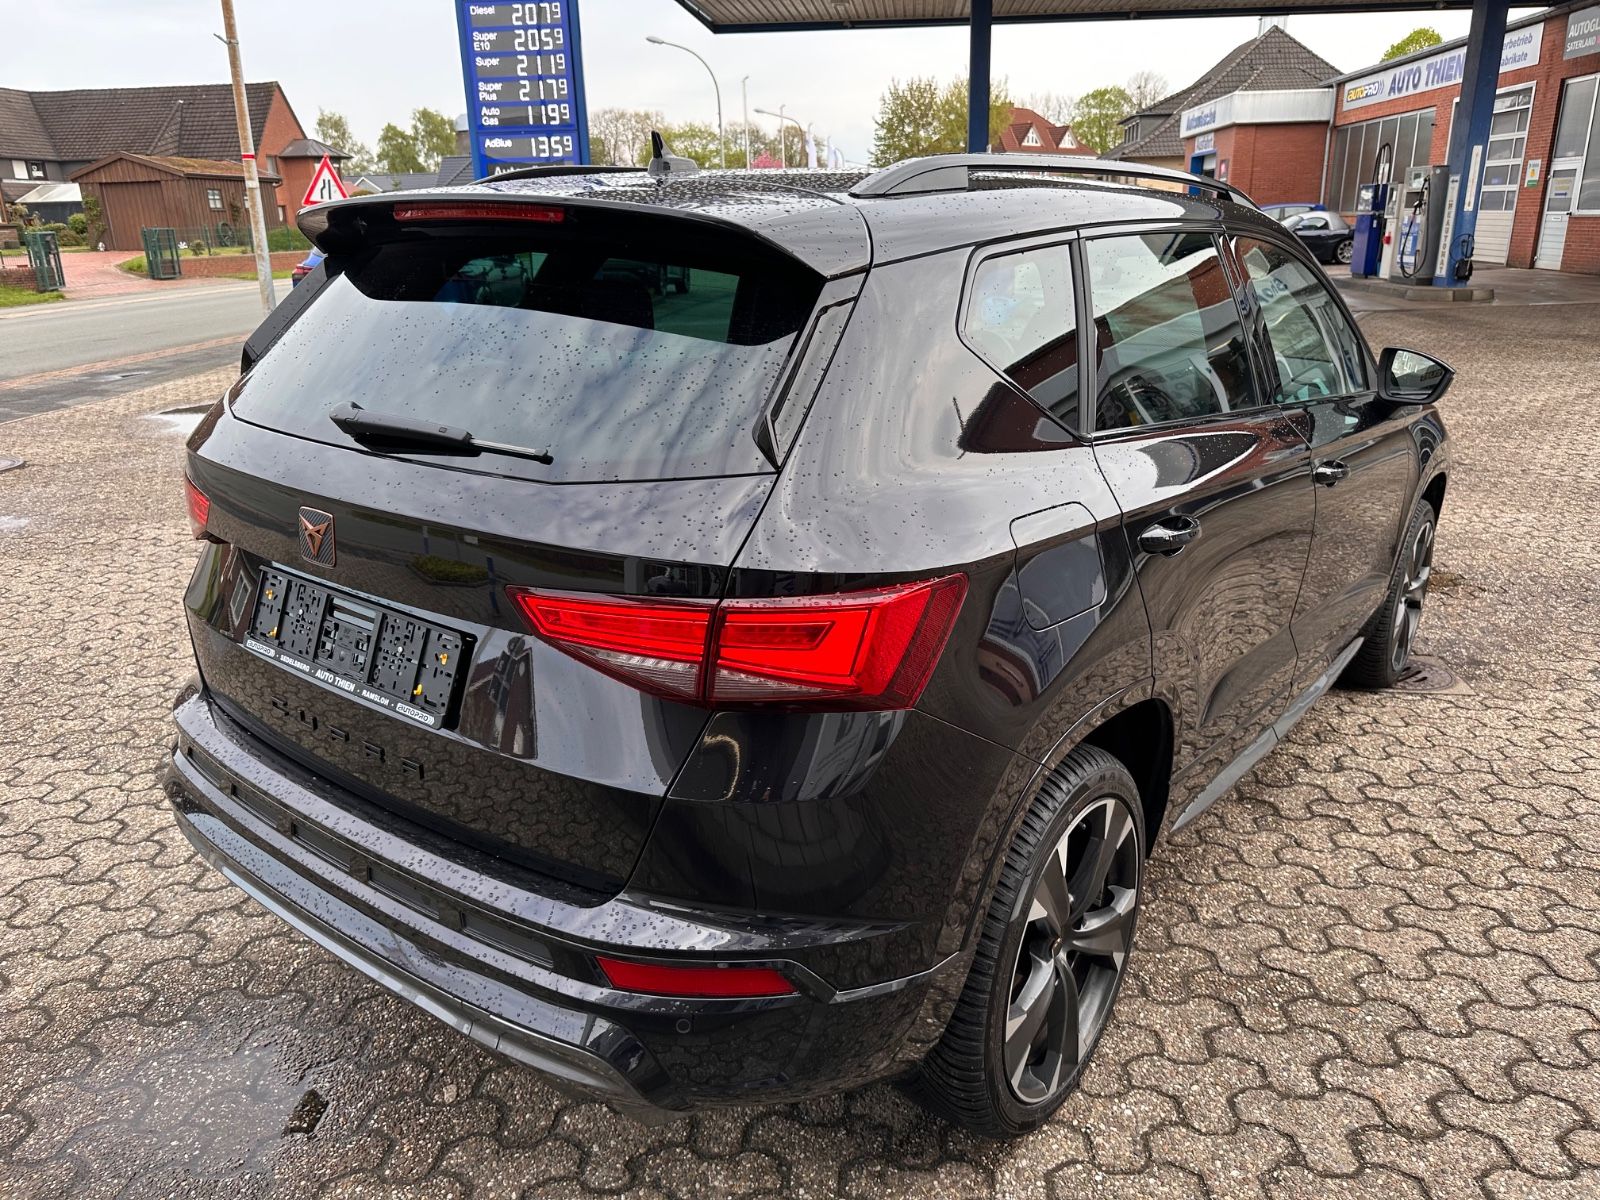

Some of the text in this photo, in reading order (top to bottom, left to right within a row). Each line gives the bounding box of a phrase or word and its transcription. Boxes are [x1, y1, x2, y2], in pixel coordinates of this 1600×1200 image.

[470, 5, 496, 15] Diesel
[473, 32, 497, 41] Super
[474, 42, 490, 51] E10
[1566, 35, 1597, 53] SATERLAND
[475, 57, 499, 67] Super
[1388, 65, 1422, 97] AUTO
[1424, 53, 1466, 87] THIEN
[478, 82, 502, 92] Super
[479, 92, 498, 101] Plus
[481, 106, 501, 116] Auto
[482, 116, 499, 126] Gas
[485, 138, 512, 148] AdBlue
[315, 668, 334, 684] AUTO
[335, 676, 356, 692] THIEN
[361, 689, 390, 706] RAMSLOH
